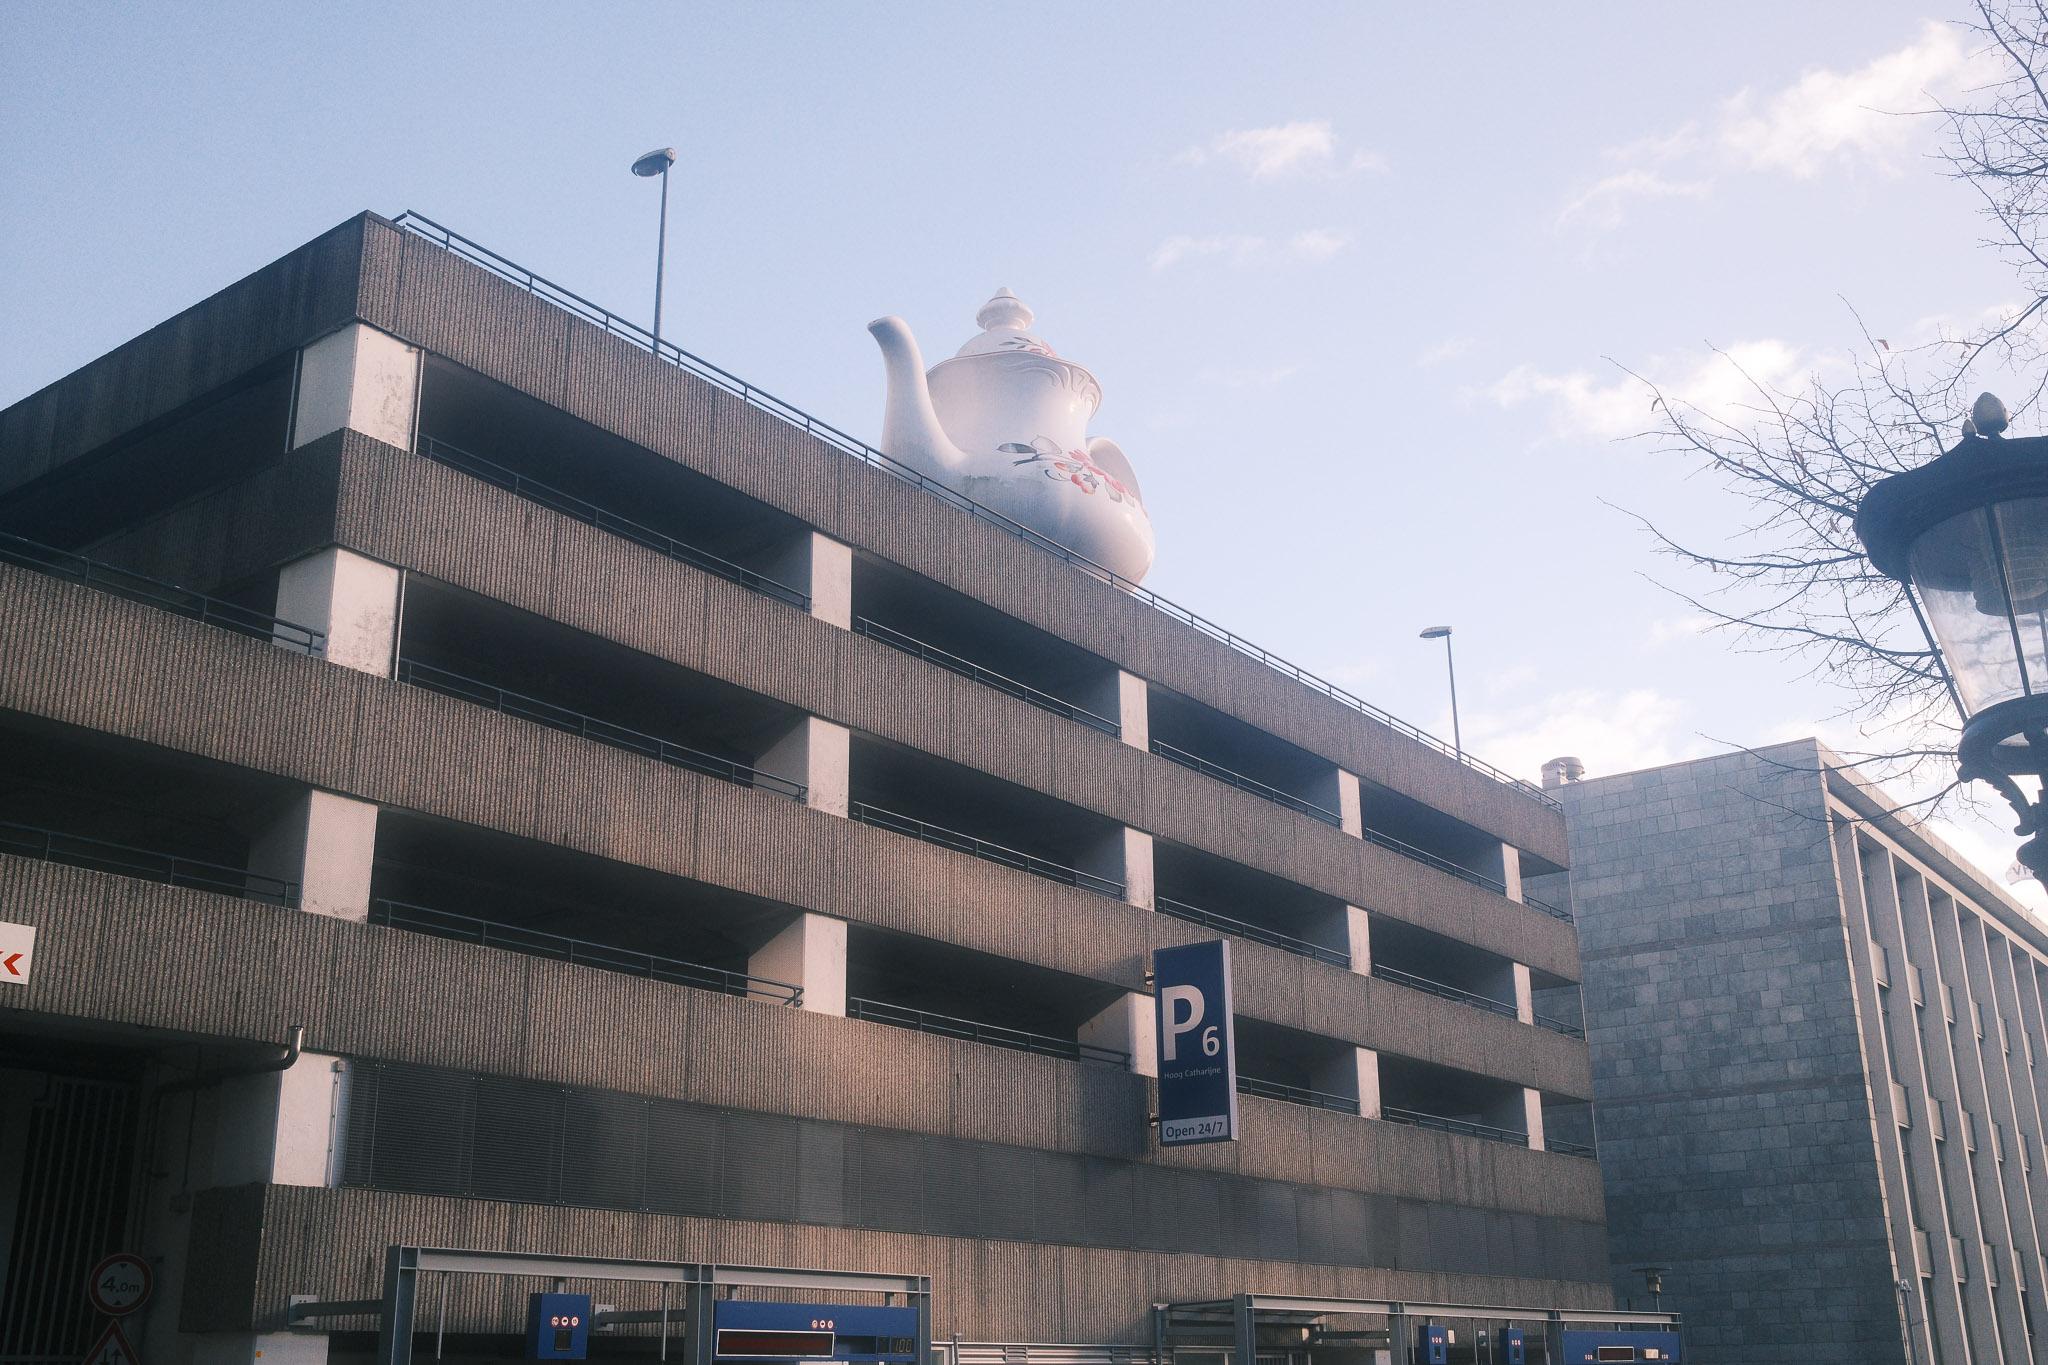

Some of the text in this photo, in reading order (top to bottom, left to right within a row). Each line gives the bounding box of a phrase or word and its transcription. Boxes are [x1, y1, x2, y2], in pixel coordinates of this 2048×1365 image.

[1164, 1066, 1222, 1080] Hoog Catharijne
[1165, 1120, 1223, 1139] Open 24/7
